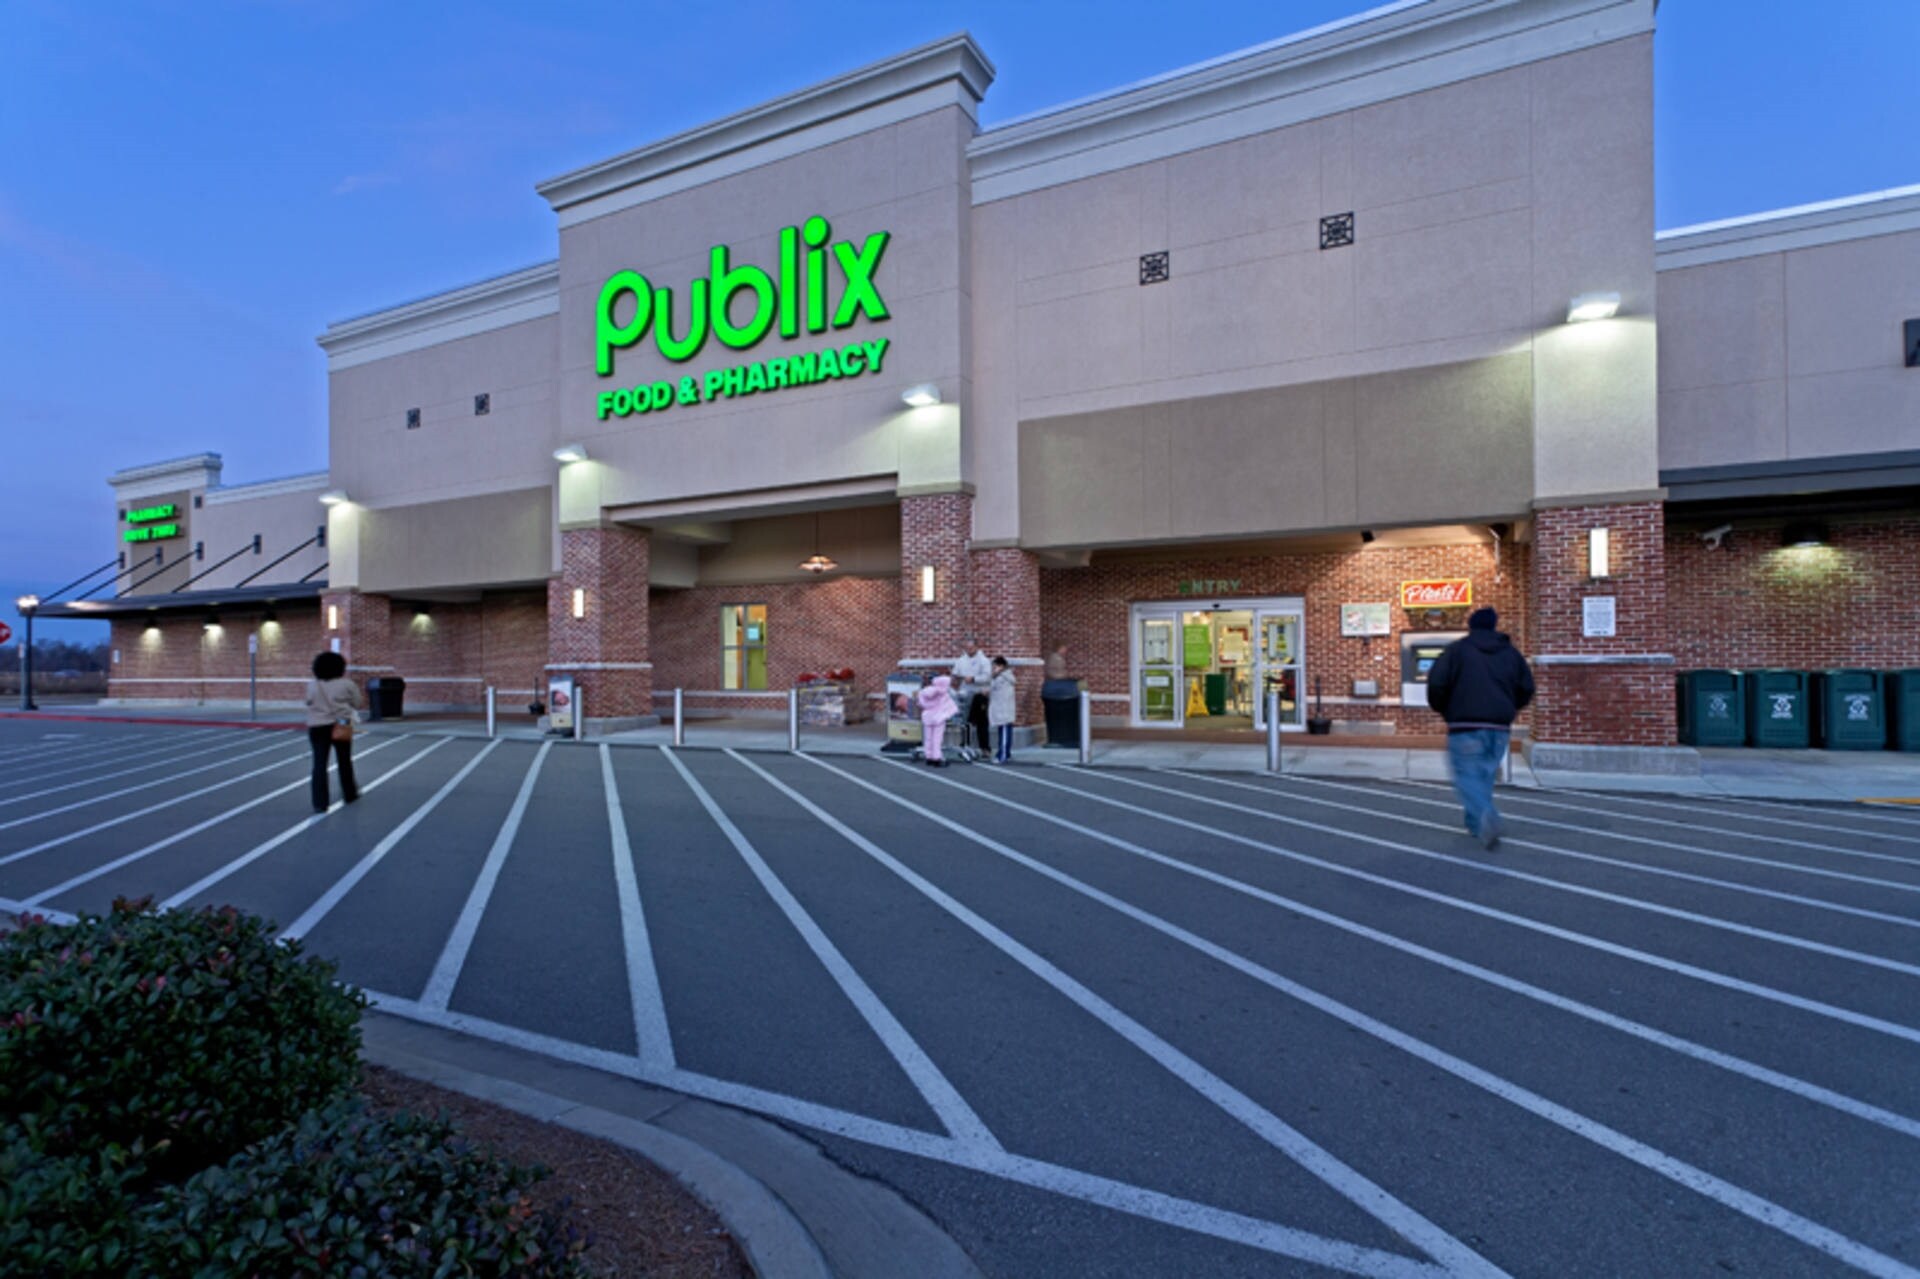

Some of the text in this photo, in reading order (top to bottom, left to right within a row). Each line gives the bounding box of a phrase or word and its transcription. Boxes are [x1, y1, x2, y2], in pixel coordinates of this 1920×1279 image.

[596, 216, 889, 376] Publix
[597, 337, 889, 420] FOOD & PHARMACY
